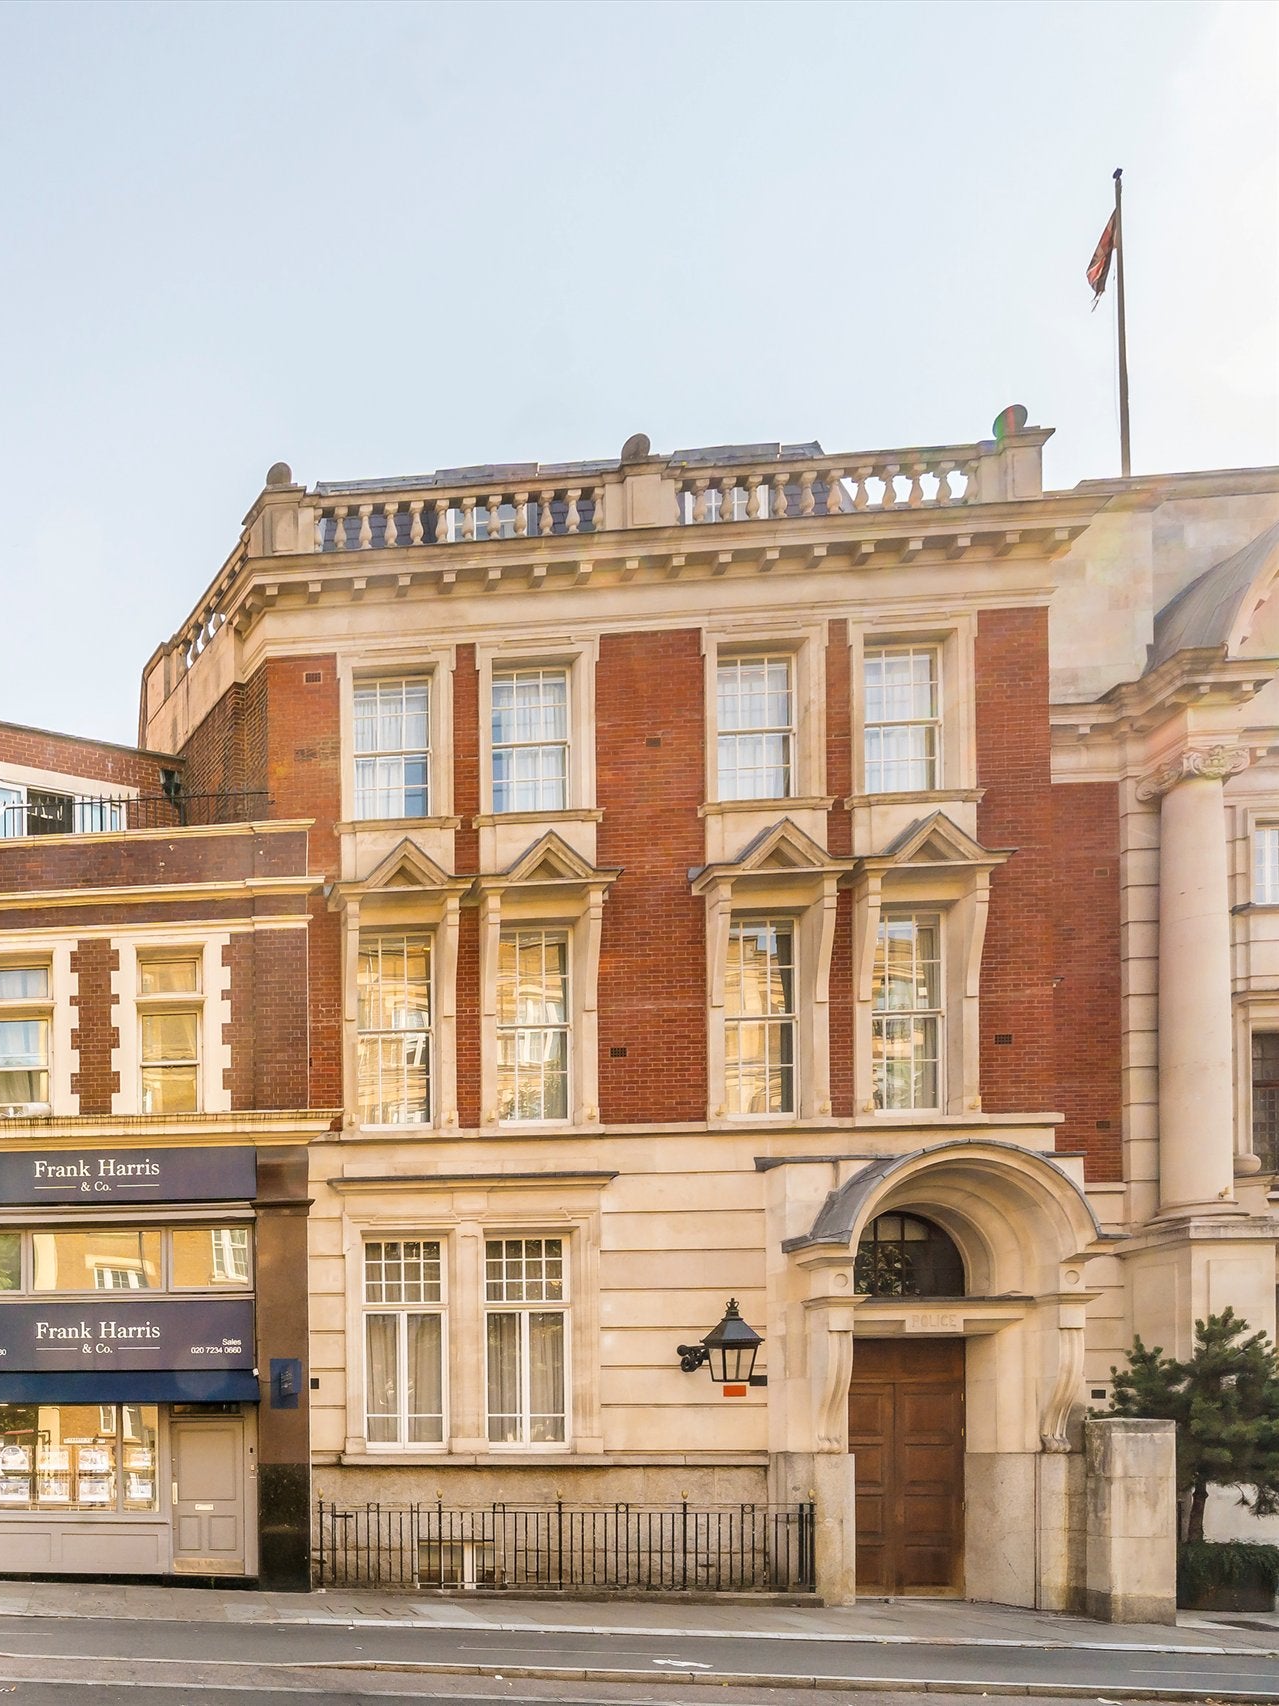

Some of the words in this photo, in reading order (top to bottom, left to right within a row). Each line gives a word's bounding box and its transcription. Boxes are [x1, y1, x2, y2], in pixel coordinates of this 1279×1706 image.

[34, 1159, 91, 1178] Frank
[98, 1158, 160, 1176] Harris
[80, 1181, 91, 1192] &
[94, 1181, 112, 1191] Co.
[911, 1314, 957, 1328] POLICE
[35, 1321, 92, 1339] Frank
[99, 1321, 160, 1338] Harris
[222, 1338, 242, 1346] Sales
[82, 1343, 92, 1353] &
[95, 1343, 113, 1353] Co.
[190, 1346, 204, 1354] 020
[205, 1346, 223, 1354] 7234
